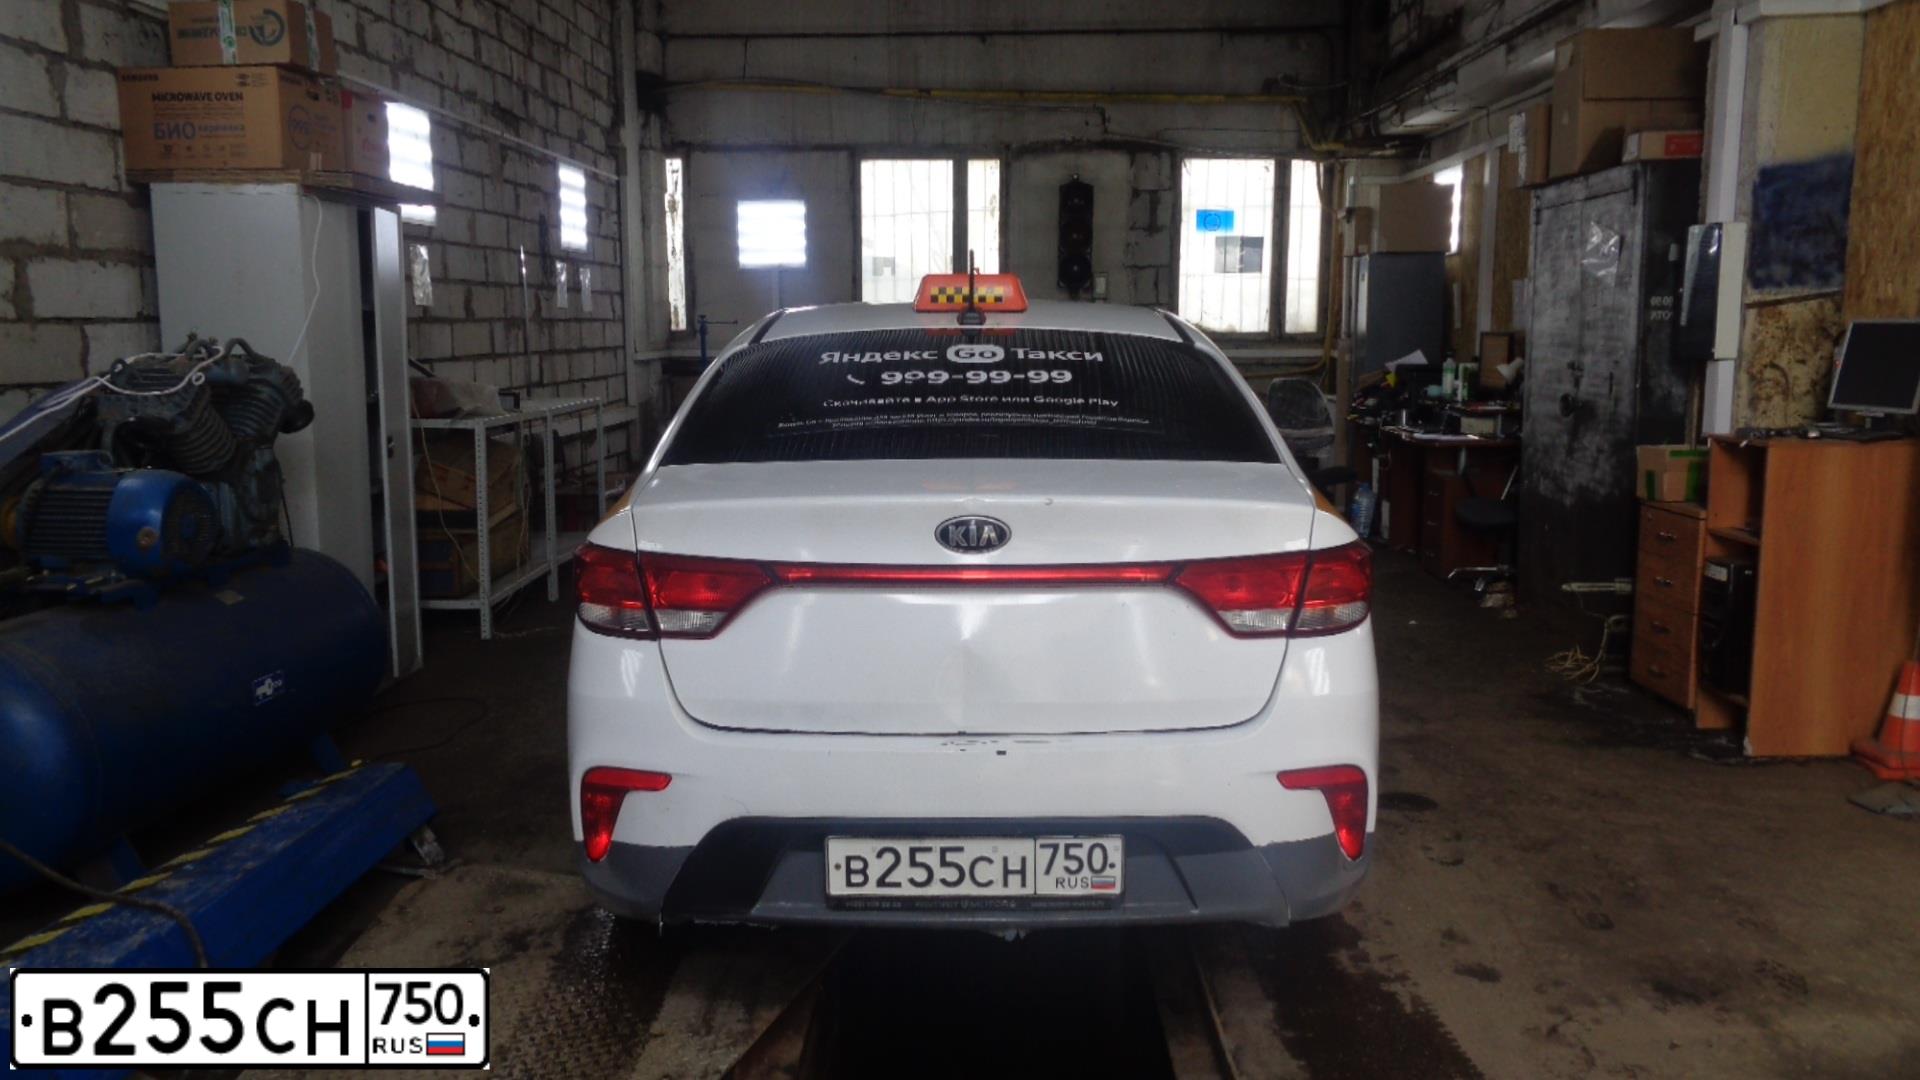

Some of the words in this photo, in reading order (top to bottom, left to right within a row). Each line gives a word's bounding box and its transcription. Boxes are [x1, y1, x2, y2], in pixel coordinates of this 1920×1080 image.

[152, 91, 214, 102] MICROWAVE
[215, 91, 243, 101] OVEN
[154, 122, 196, 140] БИО
[819, 350, 938, 364] Яндекс
[1010, 347, 1103, 362] Такси
[880, 370, 1073, 385] 999-99-99
[926, 395, 956, 405] App
[960, 394, 998, 403] Store
[1034, 395, 1085, 406] Google
[948, 522, 999, 547] KIA
[1039, 842, 1108, 876] 750
[1056, 876, 1089, 889] RUS
